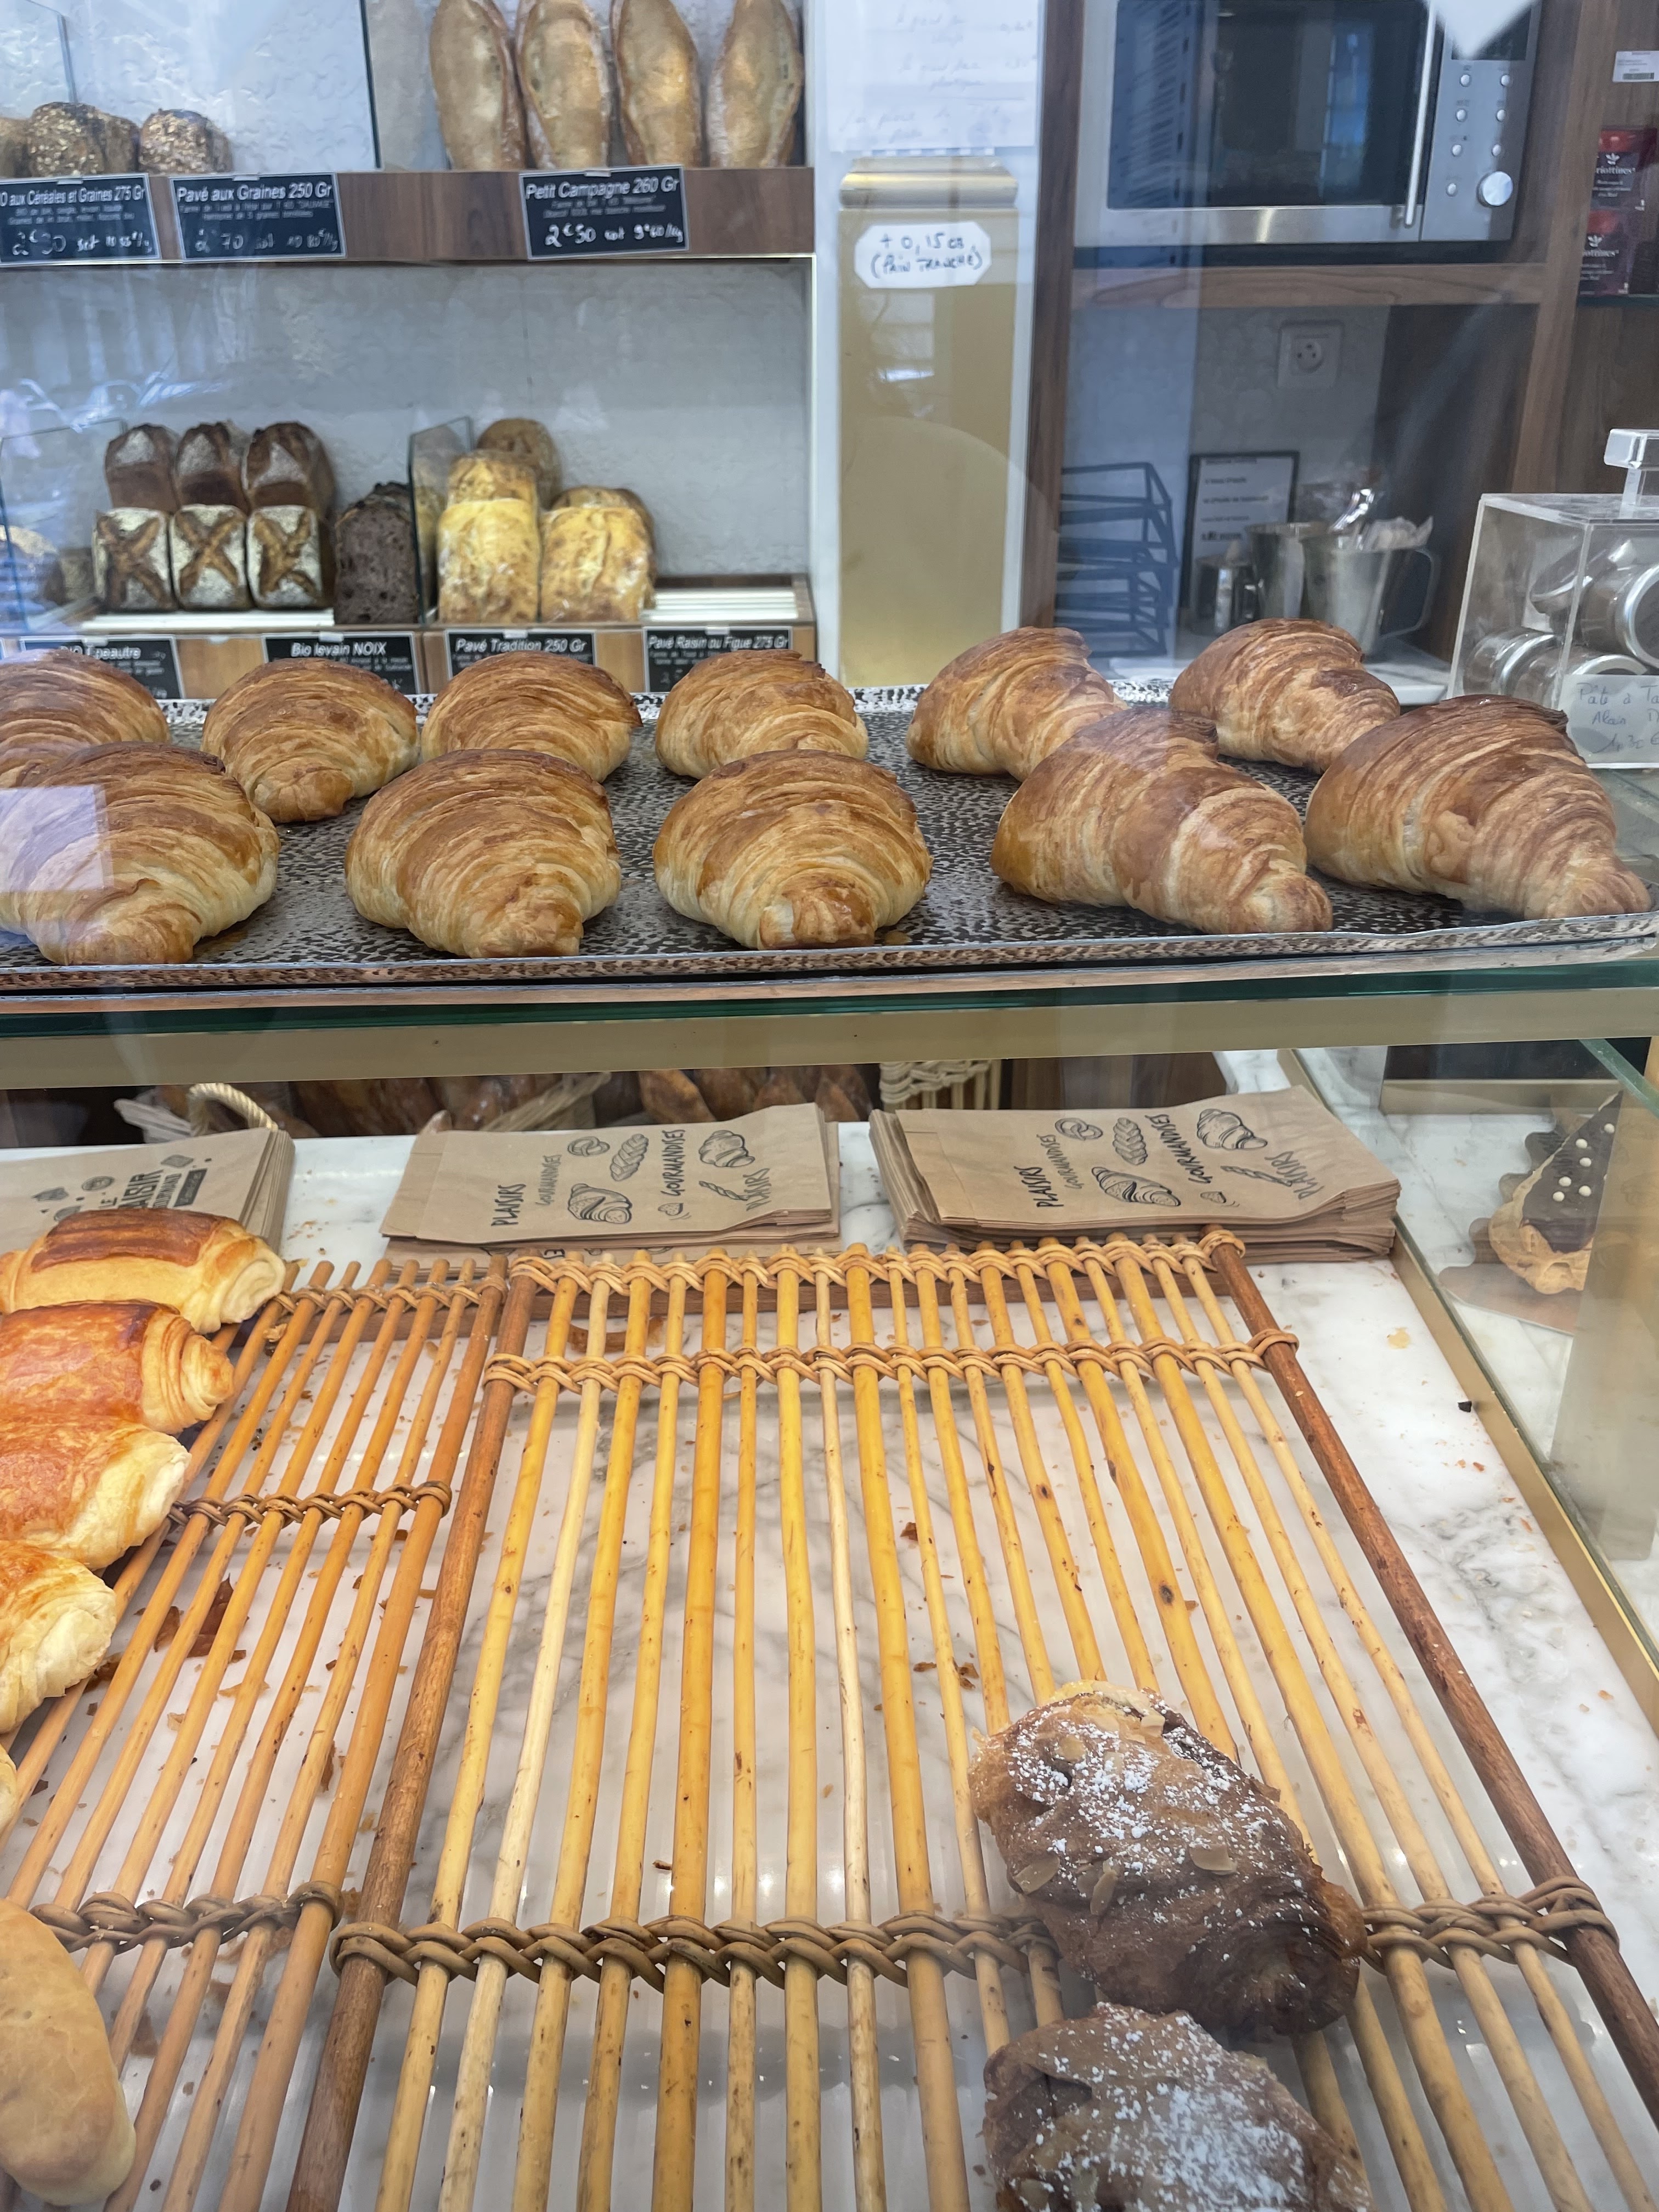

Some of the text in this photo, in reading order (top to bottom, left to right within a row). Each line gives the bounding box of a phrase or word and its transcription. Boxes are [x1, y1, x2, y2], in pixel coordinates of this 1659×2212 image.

[9, 194, 26, 206] aux
[67, 190, 77, 203] et
[78, 187, 112, 202] Graines
[114, 185, 132, 201] 275
[132, 184, 145, 200] Gr
[177, 181, 332, 202] Pavé aux Graines 250 Gr
[526, 175, 680, 200] Petit Campagne 260 Gr
[291, 641, 387, 656] Bio levain NOIX
[455, 637, 588, 653] Pavé Tradition 250 Gr
[675, 635, 707, 649] Raisin
[723, 635, 752, 651] Figue
[1145, 1114, 1212, 1184] GOURMANDISES
[661, 1129, 686, 1196] GOURMANDISES
[1014, 1166, 1064, 1207] PLAISIRS
[491, 1183, 527, 1226] PLAISIRS
